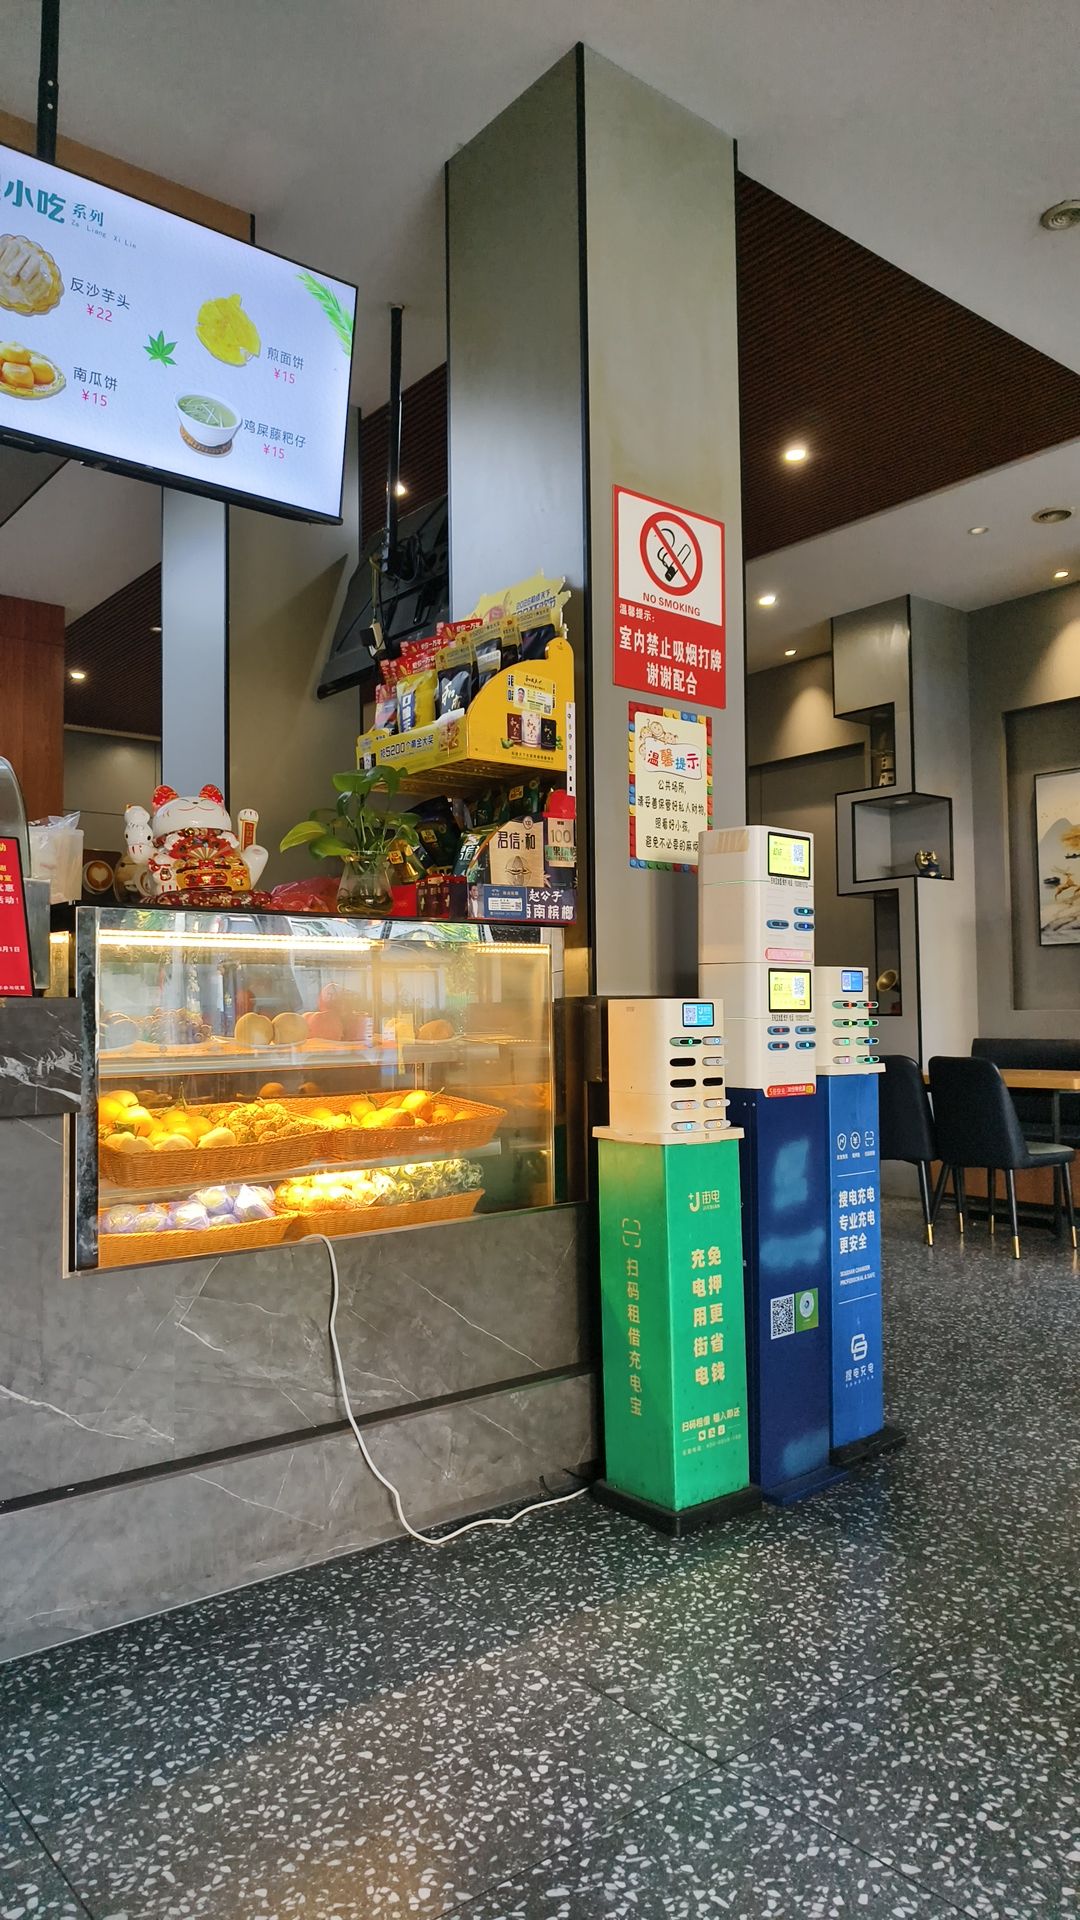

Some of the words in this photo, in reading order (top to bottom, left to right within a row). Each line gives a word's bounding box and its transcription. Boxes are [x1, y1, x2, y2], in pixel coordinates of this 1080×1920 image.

[3, 180, 66, 225] 小吃
[71, 203, 104, 227] 系列
[70, 277, 131, 310] 反沙芋头
[86, 303, 113, 323] ¥22
[267, 346, 305, 371] 煎面饼
[73, 366, 119, 393] 南瓜饼
[273, 367, 296, 384] ¥15
[82, 388, 108, 408] ¥15
[243, 418, 307, 449] 鸡屎藤粑仔
[263, 443, 285, 460] ¥15
[619, 603, 656, 623] 温馨提示：
[643, 592, 657, 604] NO
[658, 597, 700, 617] SMOKING
[619, 625, 722, 673] 室内禁止吸烟打牌
[646, 661, 698, 696] 谢谢配合
[647, 748, 700, 772] 温馨提示
[657, 779, 687, 796] 公共场所，
[529, 888, 563, 904] 赵公子
[838, 1186, 875, 1208] 搜电充电
[839, 1209, 875, 1232] 专业充电
[839, 1233, 868, 1255] 更安全
[691, 1248, 710, 1386] 充电用街电
[707, 1246, 726, 1384] 免押更省钱
[626, 1257, 642, 1417] 扫码租借充电宝
[845, 1362, 874, 1382] 搜电充电
